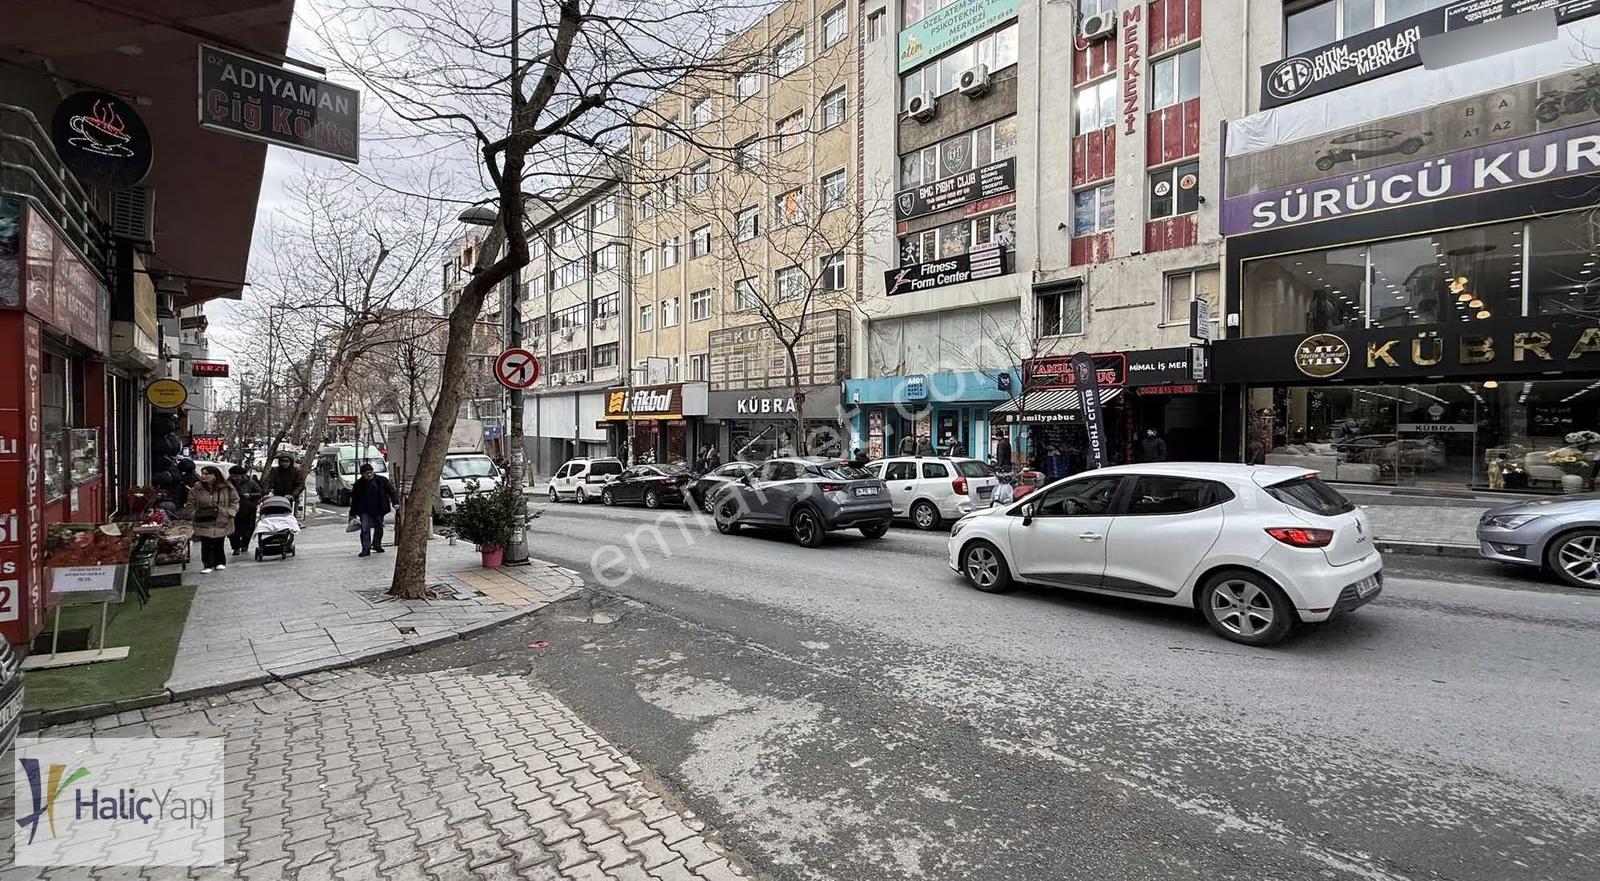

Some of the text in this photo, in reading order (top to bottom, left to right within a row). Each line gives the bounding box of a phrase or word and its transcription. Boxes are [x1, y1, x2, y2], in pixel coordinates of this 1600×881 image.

[1315, 44, 1348, 68] RİTİM
[1357, 42, 1415, 76] MERKEZİ
[1123, 5, 1141, 136] MERKEZİ
[220, 63, 348, 115] ADIYAMAN
[206, 88, 262, 132] Çiğ
[1466, 107, 1474, 117] B
[1498, 99, 1508, 109] A
[1463, 128, 1479, 139] A1
[1492, 120, 1511, 133] A2
[957, 172, 976, 189] CLUB
[1252, 134, 1600, 228] SÜRÜCÜ KUR
[921, 260, 957, 276] Fitness
[911, 278, 935, 290] Form
[937, 271, 970, 285] Center
[1366, 327, 1600, 371] KÜBRA
[1129, 362, 1156, 372] MİMAL
[1158, 361, 1166, 371] İŞ
[622, 388, 673, 412] itikbal
[737, 395, 796, 414] KÜBRA
[1085, 389, 1098, 421] CLUB
